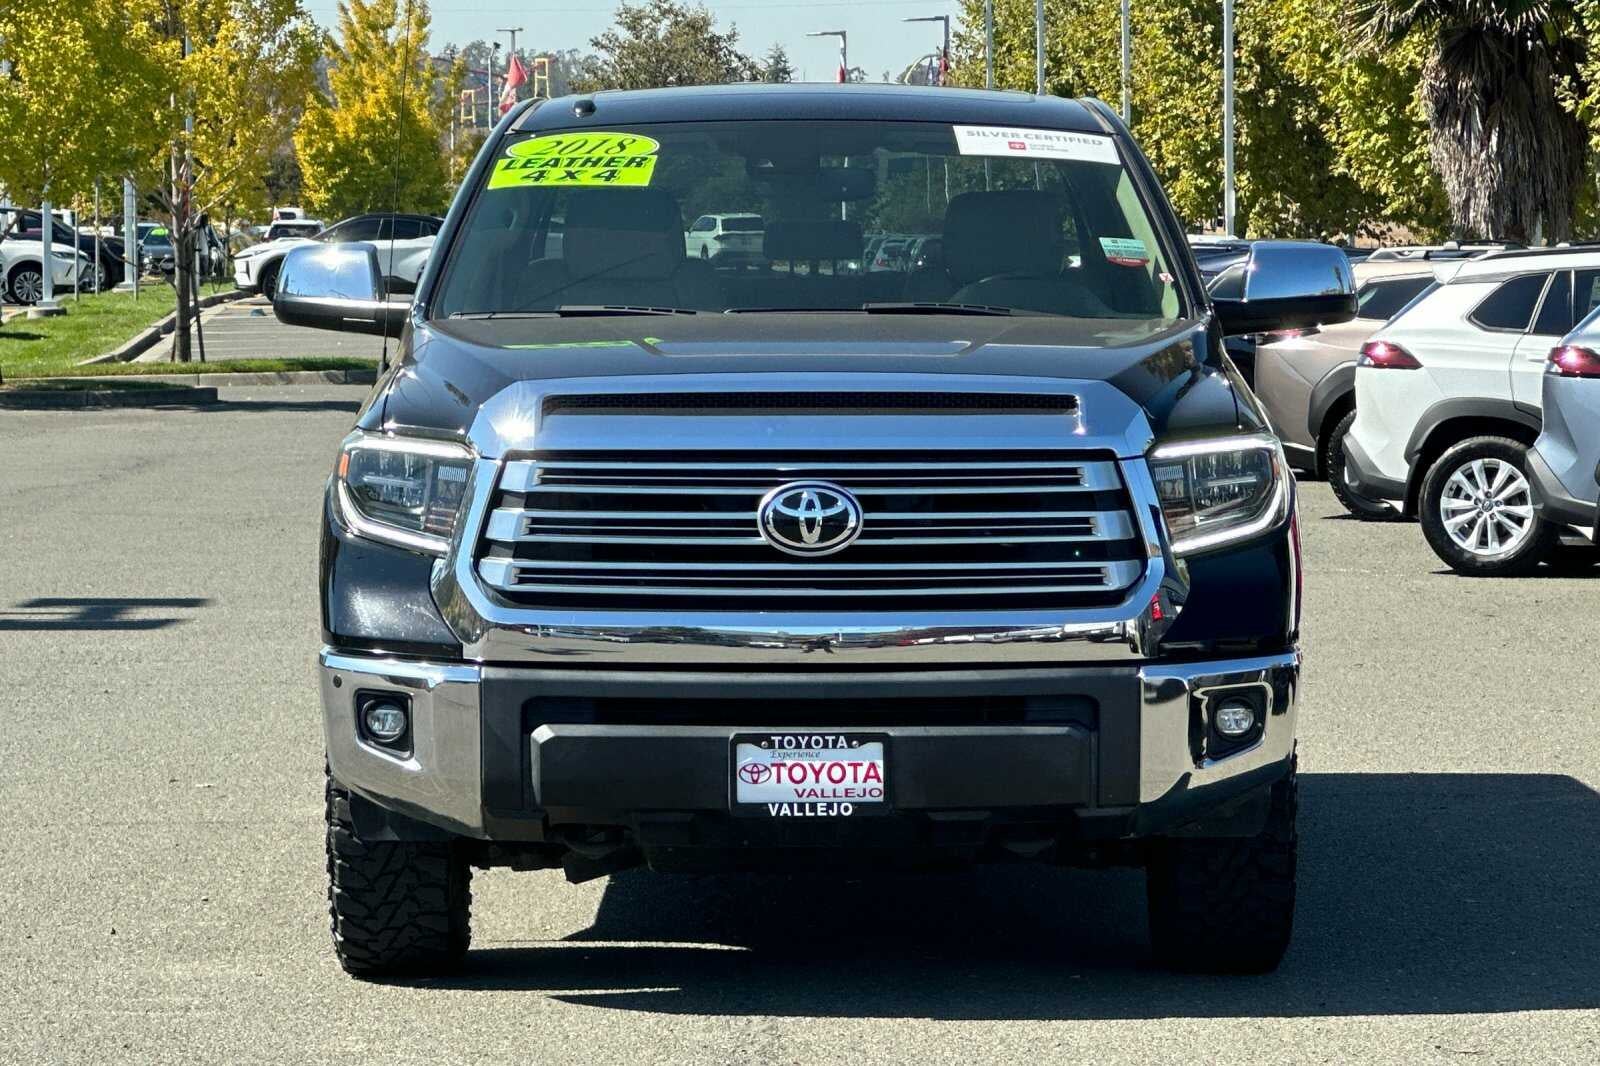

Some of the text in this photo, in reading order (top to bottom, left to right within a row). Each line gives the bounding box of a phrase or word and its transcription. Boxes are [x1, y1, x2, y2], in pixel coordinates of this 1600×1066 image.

[966, 130, 1103, 146] SILVER CERTIFIED
[532, 138, 637, 155] 2018
[502, 156, 649, 171] LEATHER
[770, 735, 849, 749] TOYOTA
[769, 750, 821, 759] Experience
[770, 761, 883, 784] TOYOTA
[793, 787, 883, 798] VALLEJO
[767, 802, 853, 817] VALLEJO
